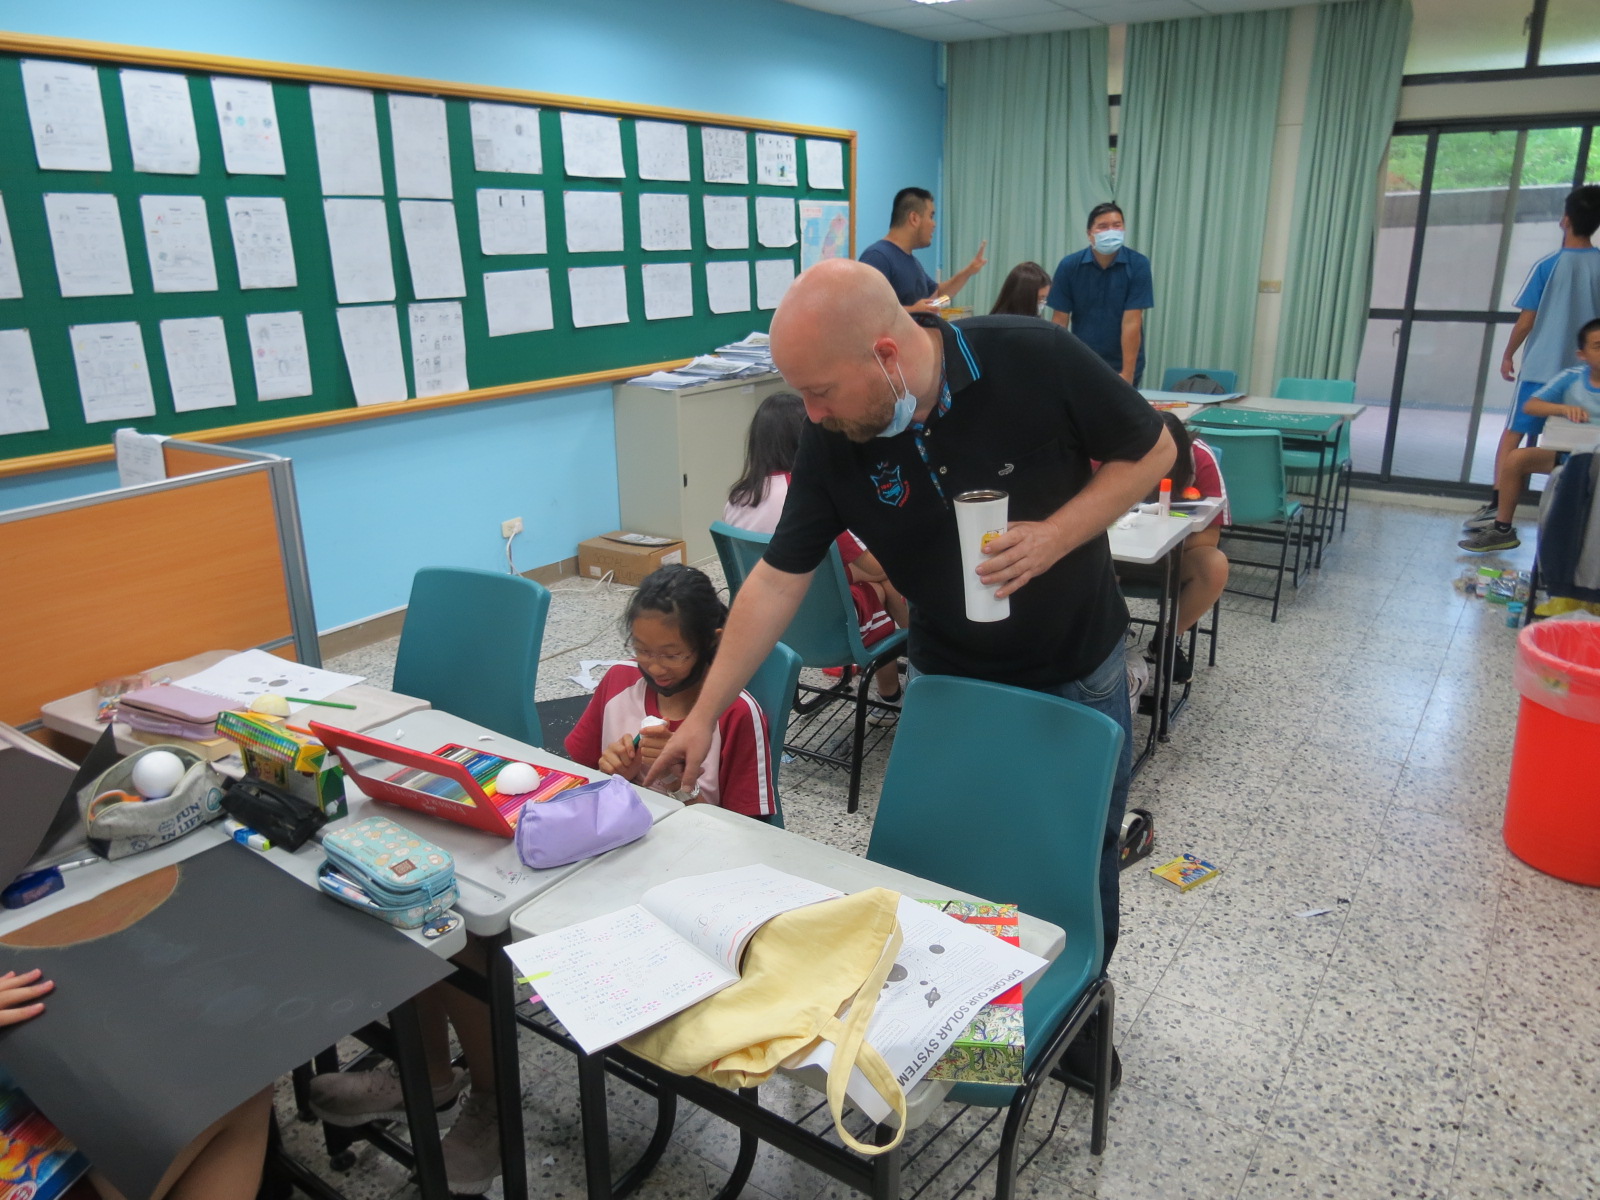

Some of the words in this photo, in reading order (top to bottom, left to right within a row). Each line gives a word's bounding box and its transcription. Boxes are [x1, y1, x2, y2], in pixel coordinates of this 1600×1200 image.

[176, 802, 200, 823] FUN
[179, 813, 203, 833] LIFE
[987, 969, 1024, 993] EXPLORE
[967, 992, 988, 1006] OUR
[936, 1005, 970, 1040] SOLAR
[897, 1038, 939, 1087] SYSTEM
